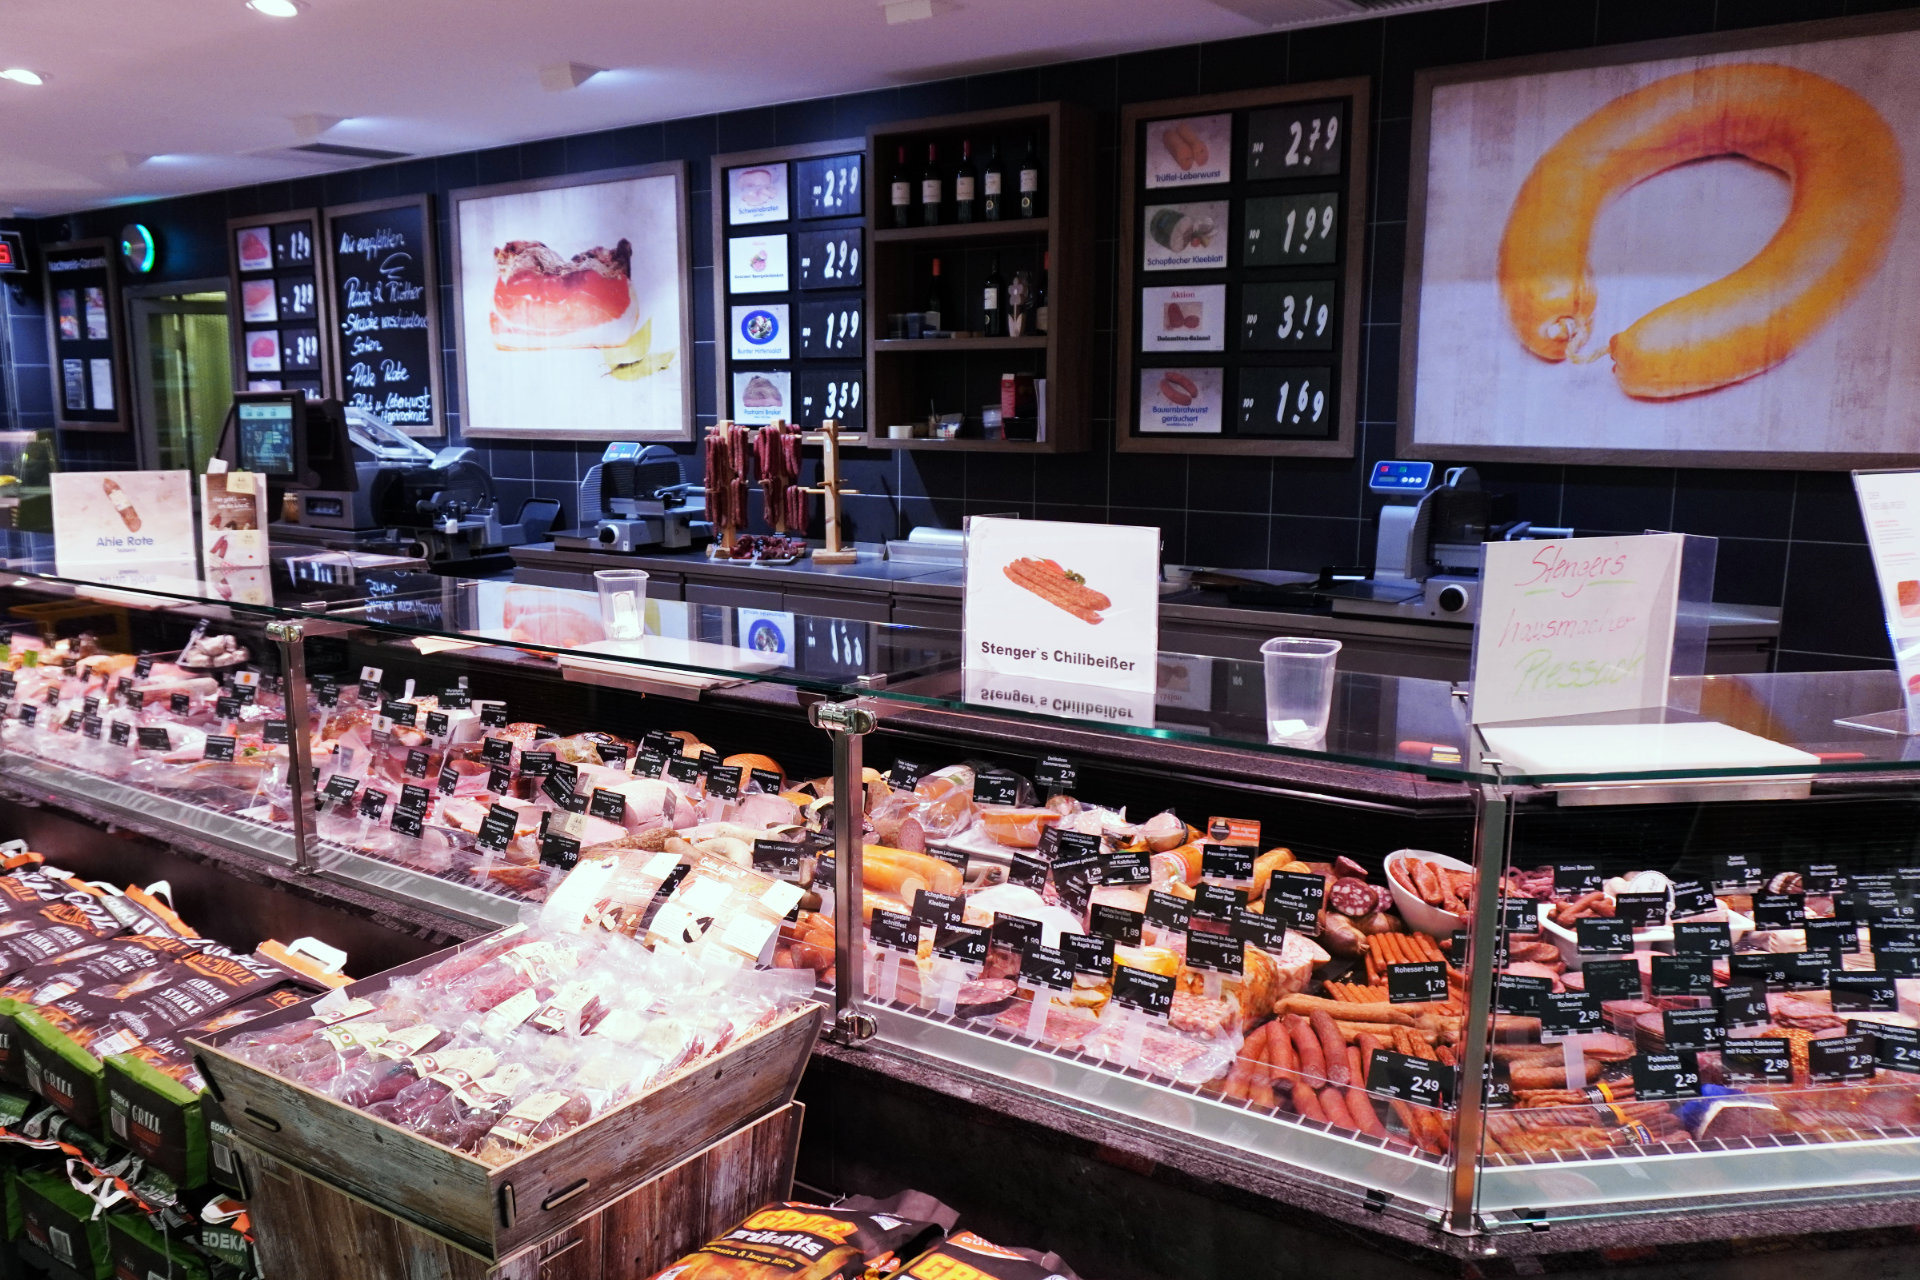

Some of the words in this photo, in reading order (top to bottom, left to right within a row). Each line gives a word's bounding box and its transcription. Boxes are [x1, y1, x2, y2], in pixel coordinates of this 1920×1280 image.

[1285, 116, 1338, 166] 2.79
[1155, 170, 1221, 182] Trüffel-Leberwurst
[1283, 205, 1333, 253] 1.99
[824, 240, 859, 279] 2.99
[1278, 294, 1329, 339] 3.19
[825, 310, 860, 349] 1.99
[1277, 380, 1325, 424] 1.69
[1152, 405, 1208, 415] Bauernbratwurst
[96, 536, 125, 547] Ahle
[126, 536, 154, 546] Rote
[1053, 650, 1136, 671] Chilibeißer
[999, 788, 1015, 798] 2.49
[782, 856, 798, 867] 1.29
[1234, 861, 1252, 872] 1.59
[1084, 867, 1102, 879] 1.29
[1131, 867, 1149, 877] 0.99
[1583, 876, 1602, 886] 4.49
[1296, 911, 1315, 922] 1.59
[1892, 907, 1915, 917] 1.69
[1173, 913, 1189, 924] 1.89
[1517, 913, 1537, 924] 1.69
[944, 923, 982, 936] Zungenwurst
[1121, 926, 1140, 938] 1.89
[900, 932, 917, 944] 1.69
[1263, 932, 1282, 944] 1.49
[1611, 934, 1632, 945] 3.49
[967, 942, 986, 955] 1.89
[1709, 939, 1730, 951] 2.49
[1092, 954, 1112, 967] 1.89
[1221, 952, 1242, 965] 1.29
[1052, 967, 1072, 980] 2.49
[1394, 966, 1424, 974] Rohesser
[1424, 964, 1439, 973] lang
[1425, 980, 1446, 992] 1.79
[1689, 974, 1712, 986] 2.99
[1149, 992, 1171, 1006] 1.19
[1747, 1002, 1767, 1015] 4.49
[1578, 1010, 1600, 1023] 2.99
[1703, 1027, 1726, 1041] 3.19
[1647, 1054, 1680, 1063] Polnische
[1849, 1055, 1873, 1069] 2.29
[1764, 1058, 1790, 1073] 2.99
[1410, 1076, 1440, 1093] 2.49
[1674, 1073, 1699, 1088] 2.29
[132, 1104, 162, 1134] GRILL
[202, 1231, 247, 1251] EDEKA
